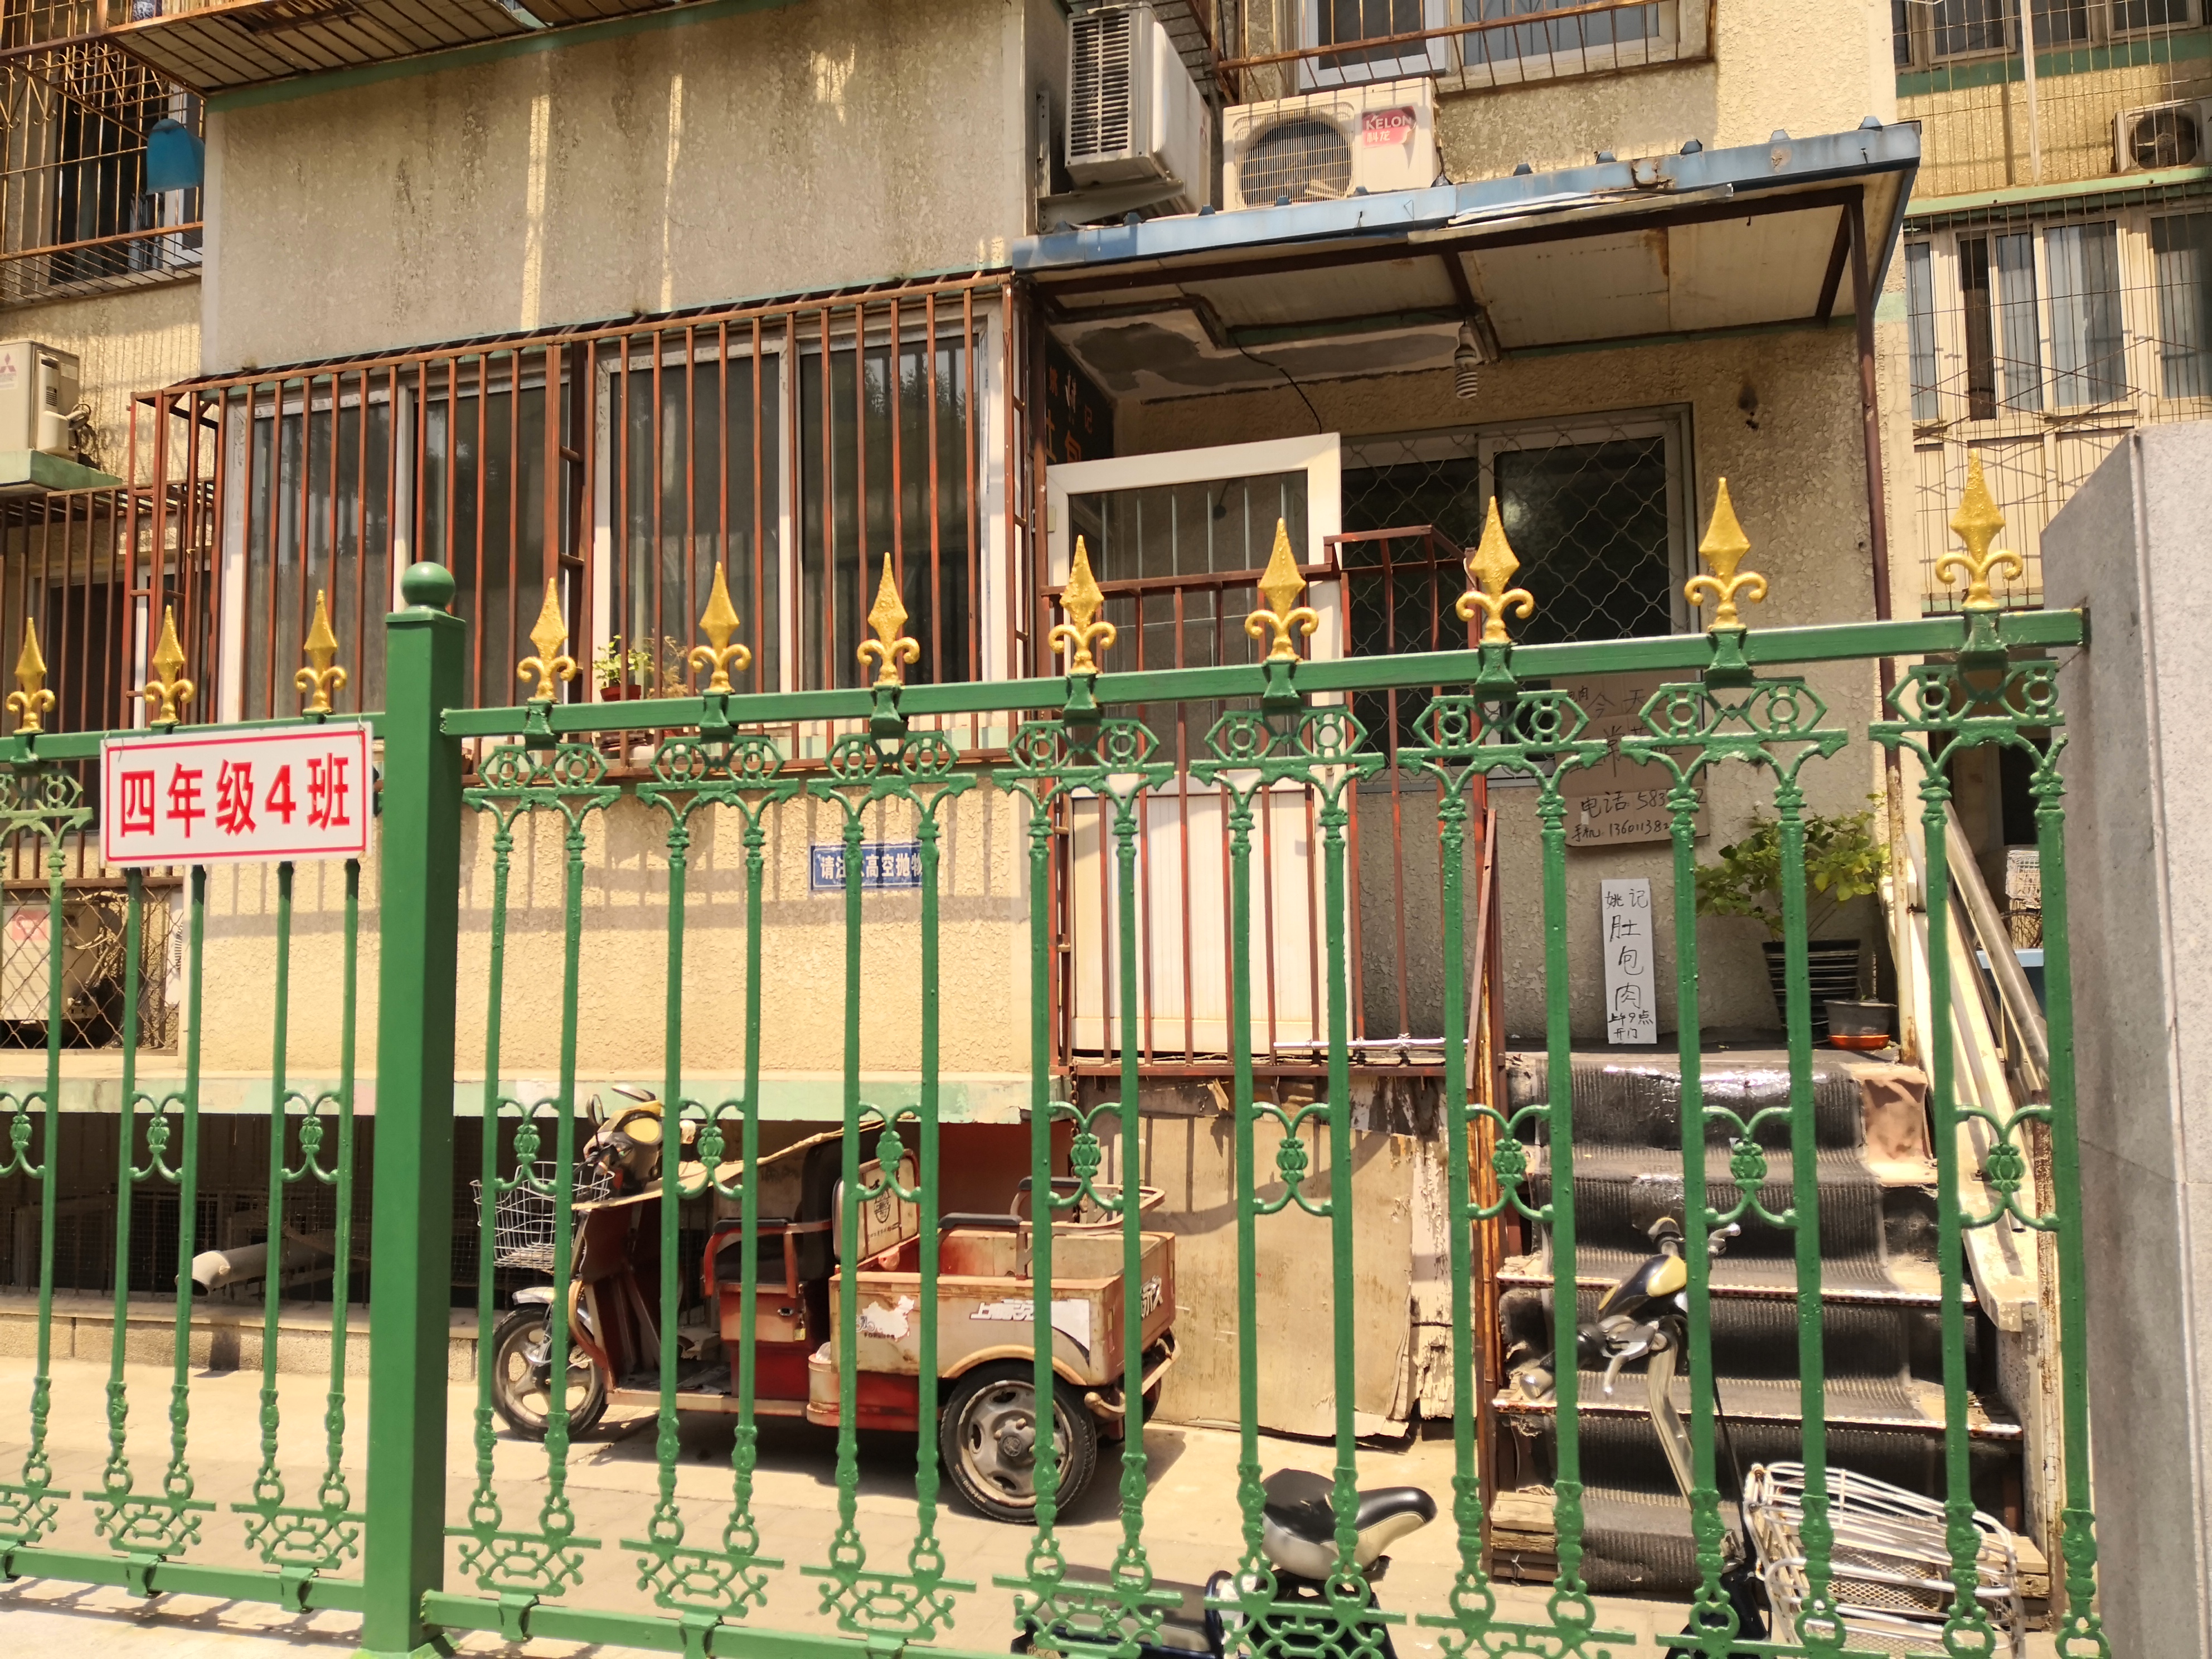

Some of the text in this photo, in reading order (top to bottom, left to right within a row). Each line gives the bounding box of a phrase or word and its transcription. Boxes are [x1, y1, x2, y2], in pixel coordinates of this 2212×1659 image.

[1366, 114, 1412, 130] KELON
[1366, 130, 1390, 143] 科龙
[120, 753, 350, 838] 四年级4班
[820, 853, 923, 879] 请注高空抛物
[1604, 889, 1648, 910] 姚记
[1609, 914, 1644, 1011] 肚包肉
[1613, 1027, 1637, 1041] 开门
